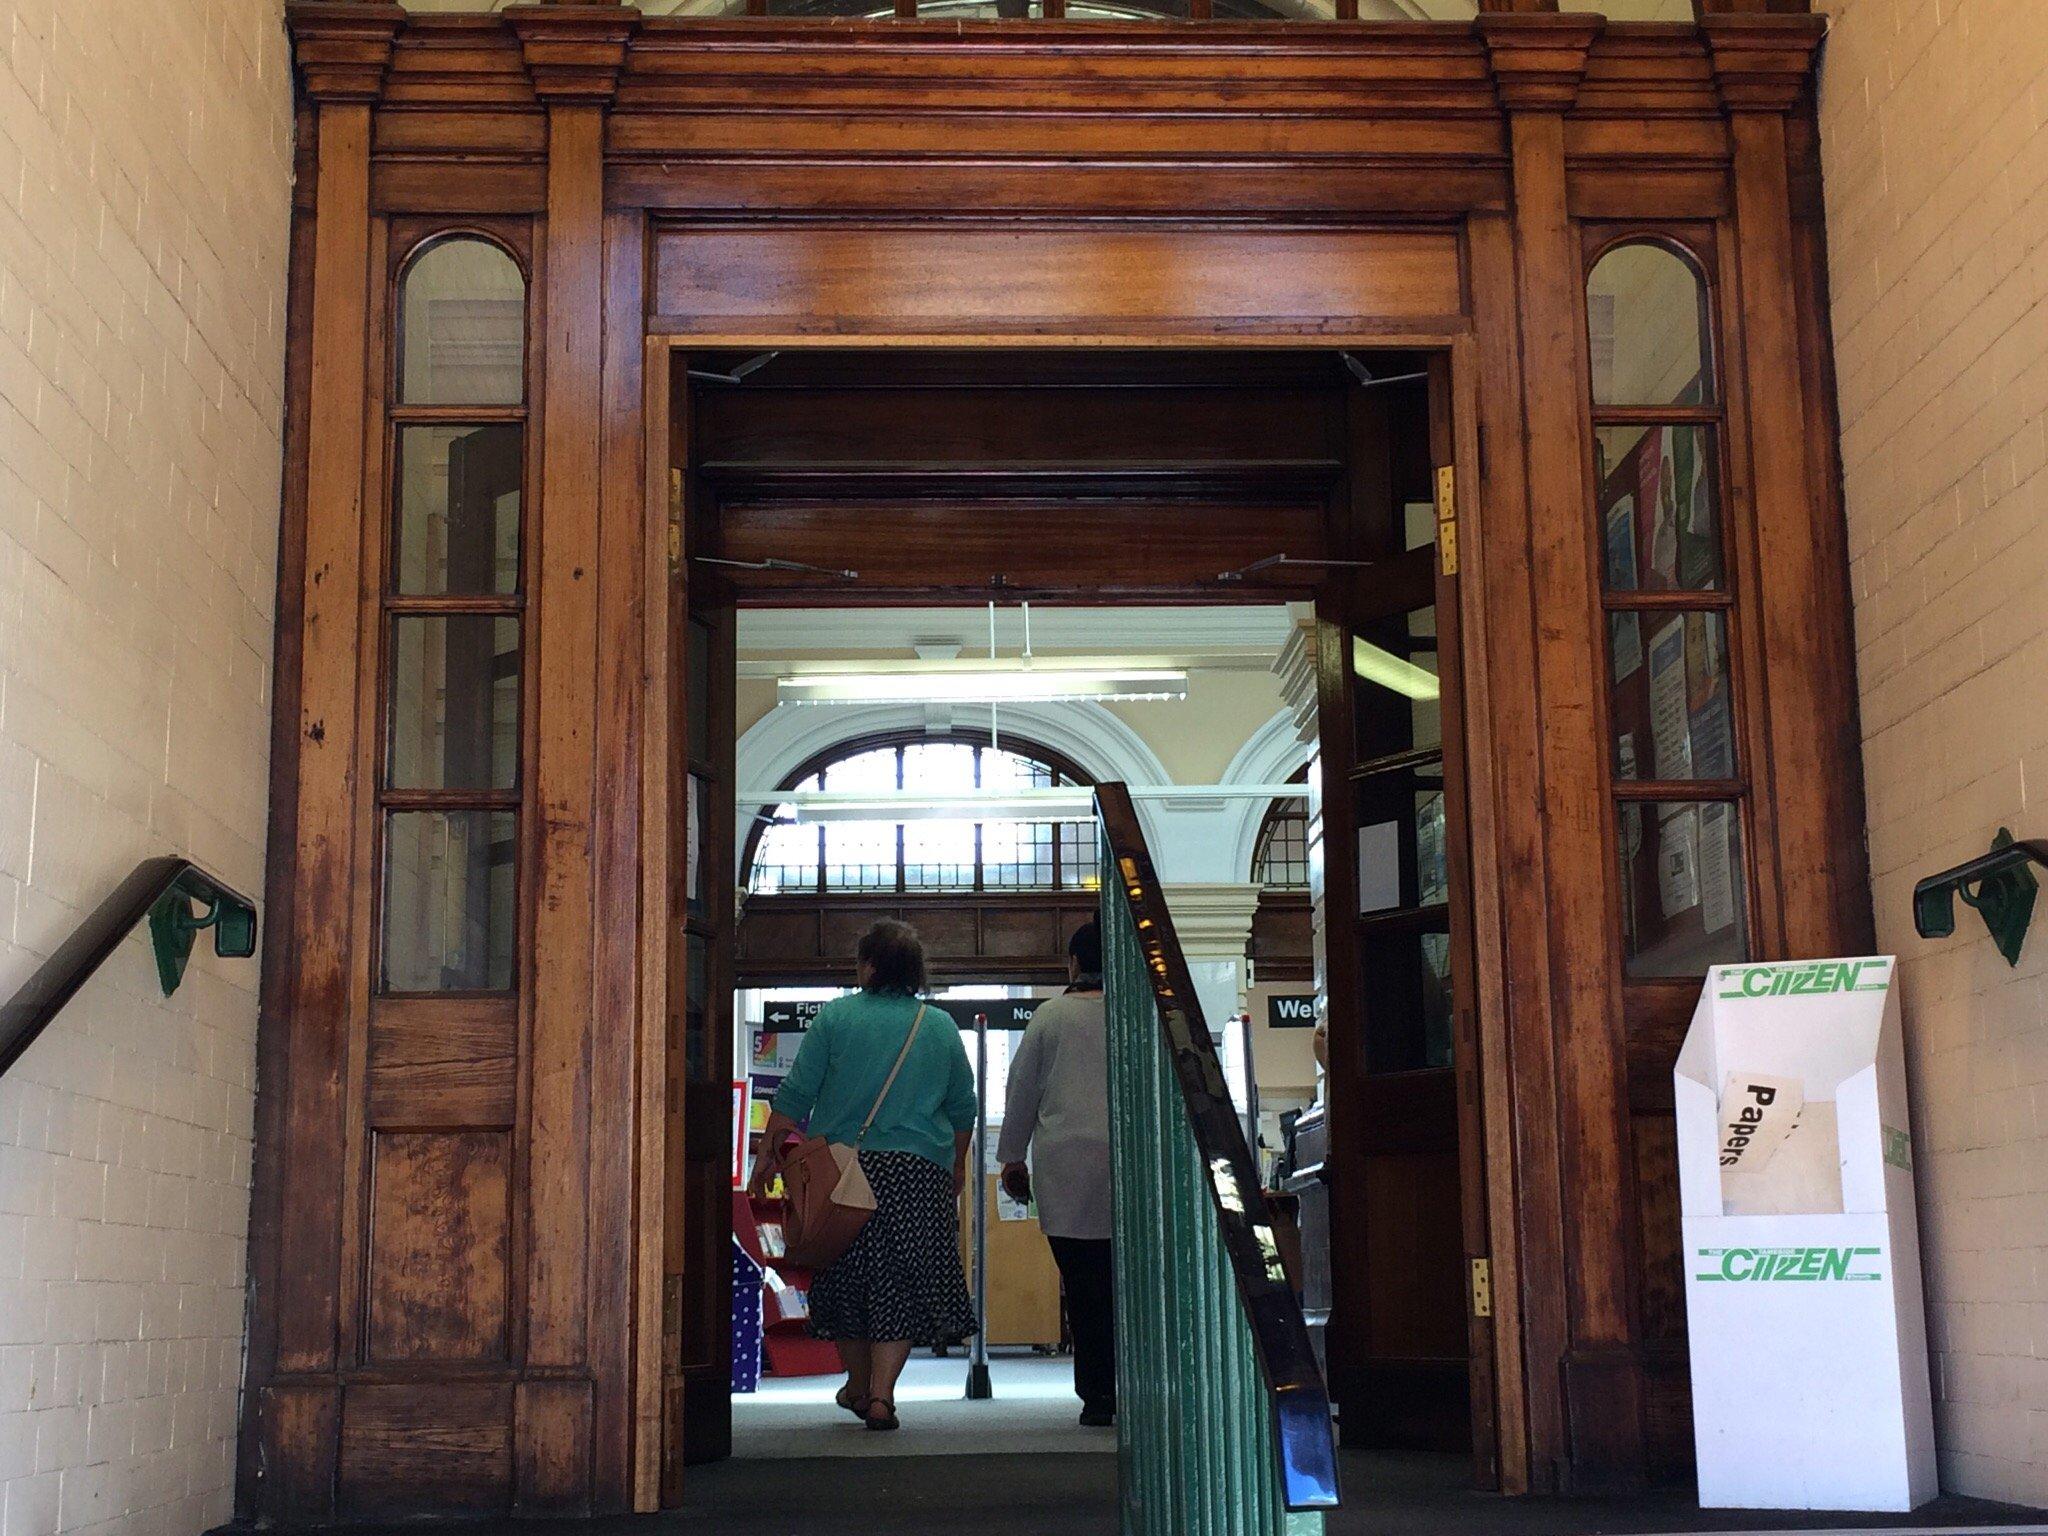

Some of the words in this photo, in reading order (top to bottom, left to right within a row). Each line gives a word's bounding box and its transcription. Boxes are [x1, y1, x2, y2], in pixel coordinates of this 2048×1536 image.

[796, 1003, 826, 1015] Fict
[797, 1017, 814, 1029] Ta
[1720, 1084, 1777, 1166] Papers
